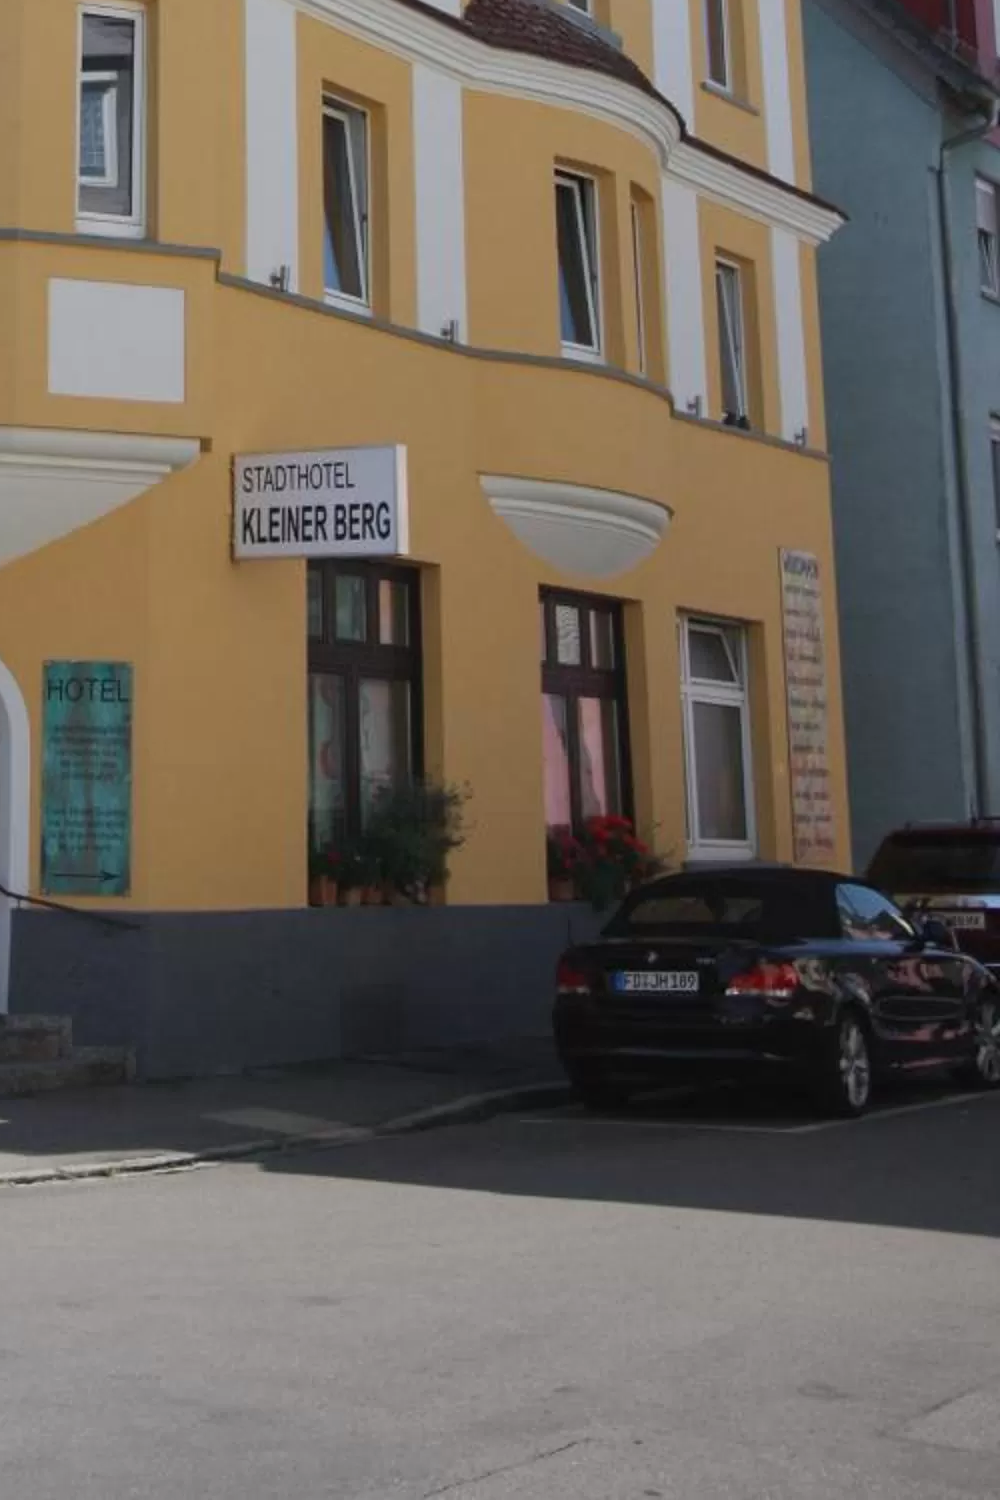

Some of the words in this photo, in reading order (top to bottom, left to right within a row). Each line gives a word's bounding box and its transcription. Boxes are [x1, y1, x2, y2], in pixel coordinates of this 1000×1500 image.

[242, 462, 356, 493] STADTHOTEL
[242, 504, 328, 544] KLEINER
[334, 501, 391, 541] BERG
[47, 678, 129, 702] HOTEL
